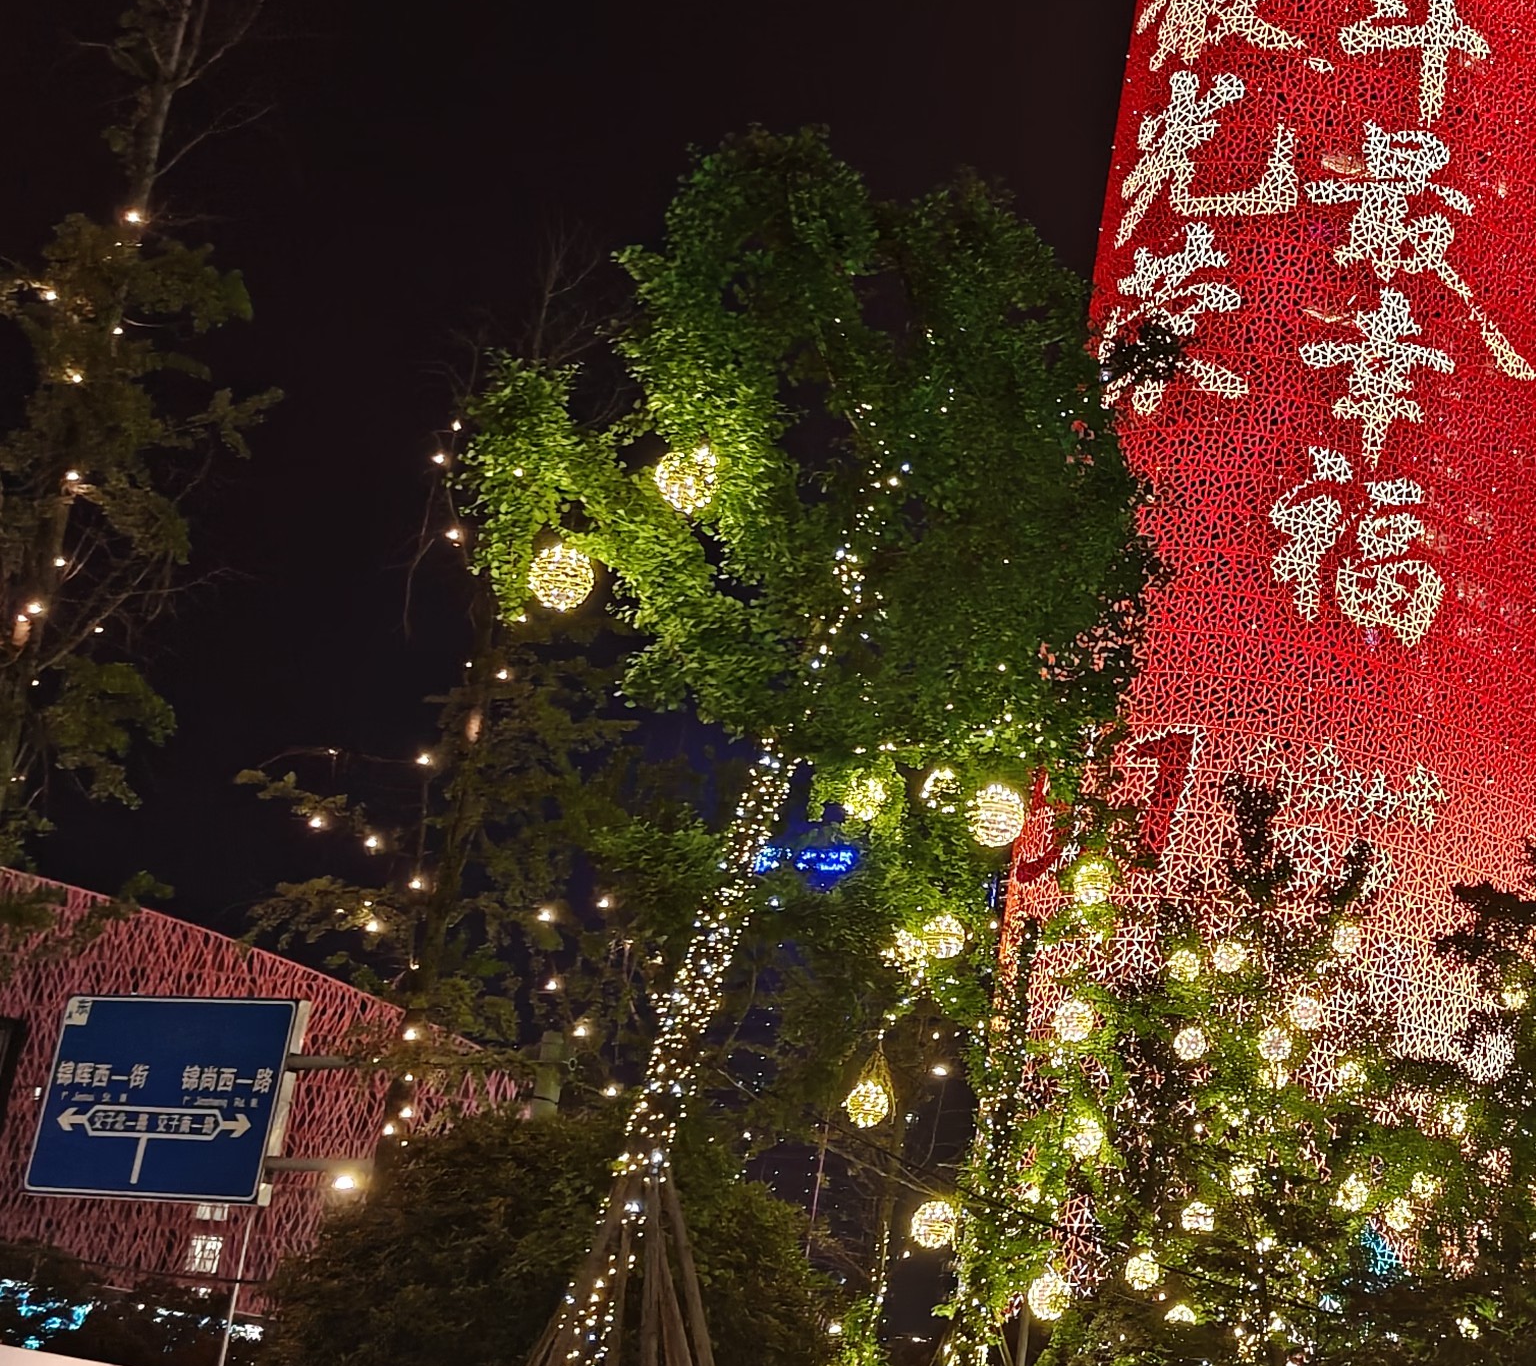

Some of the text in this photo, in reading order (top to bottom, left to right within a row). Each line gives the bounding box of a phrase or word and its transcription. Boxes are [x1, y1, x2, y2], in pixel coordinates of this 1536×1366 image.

[181, 1064, 274, 1094] 锦尚西一路
